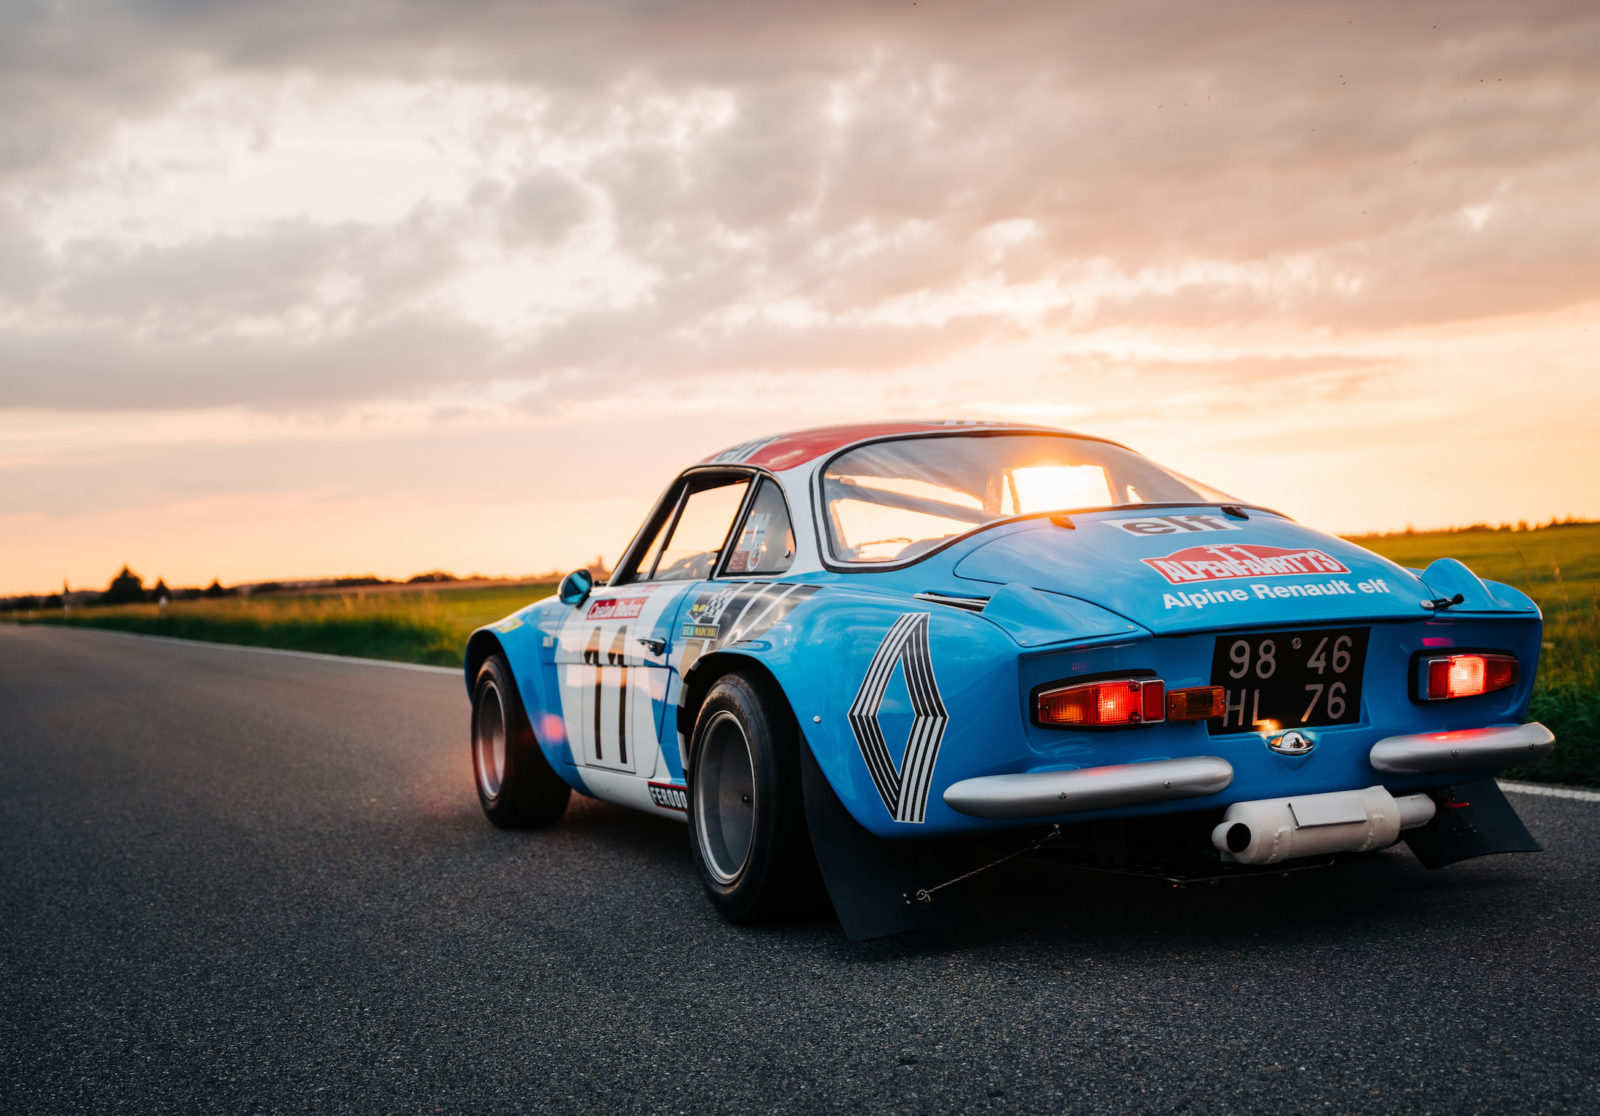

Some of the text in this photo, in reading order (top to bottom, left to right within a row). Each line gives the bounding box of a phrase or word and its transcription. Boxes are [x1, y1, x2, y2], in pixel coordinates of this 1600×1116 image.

[1122, 515, 1229, 535] elf
[1163, 579, 1391, 609] Alpine Renault elf
[1229, 635, 1353, 679] 98 46
[1223, 681, 1347, 728] HL 76
